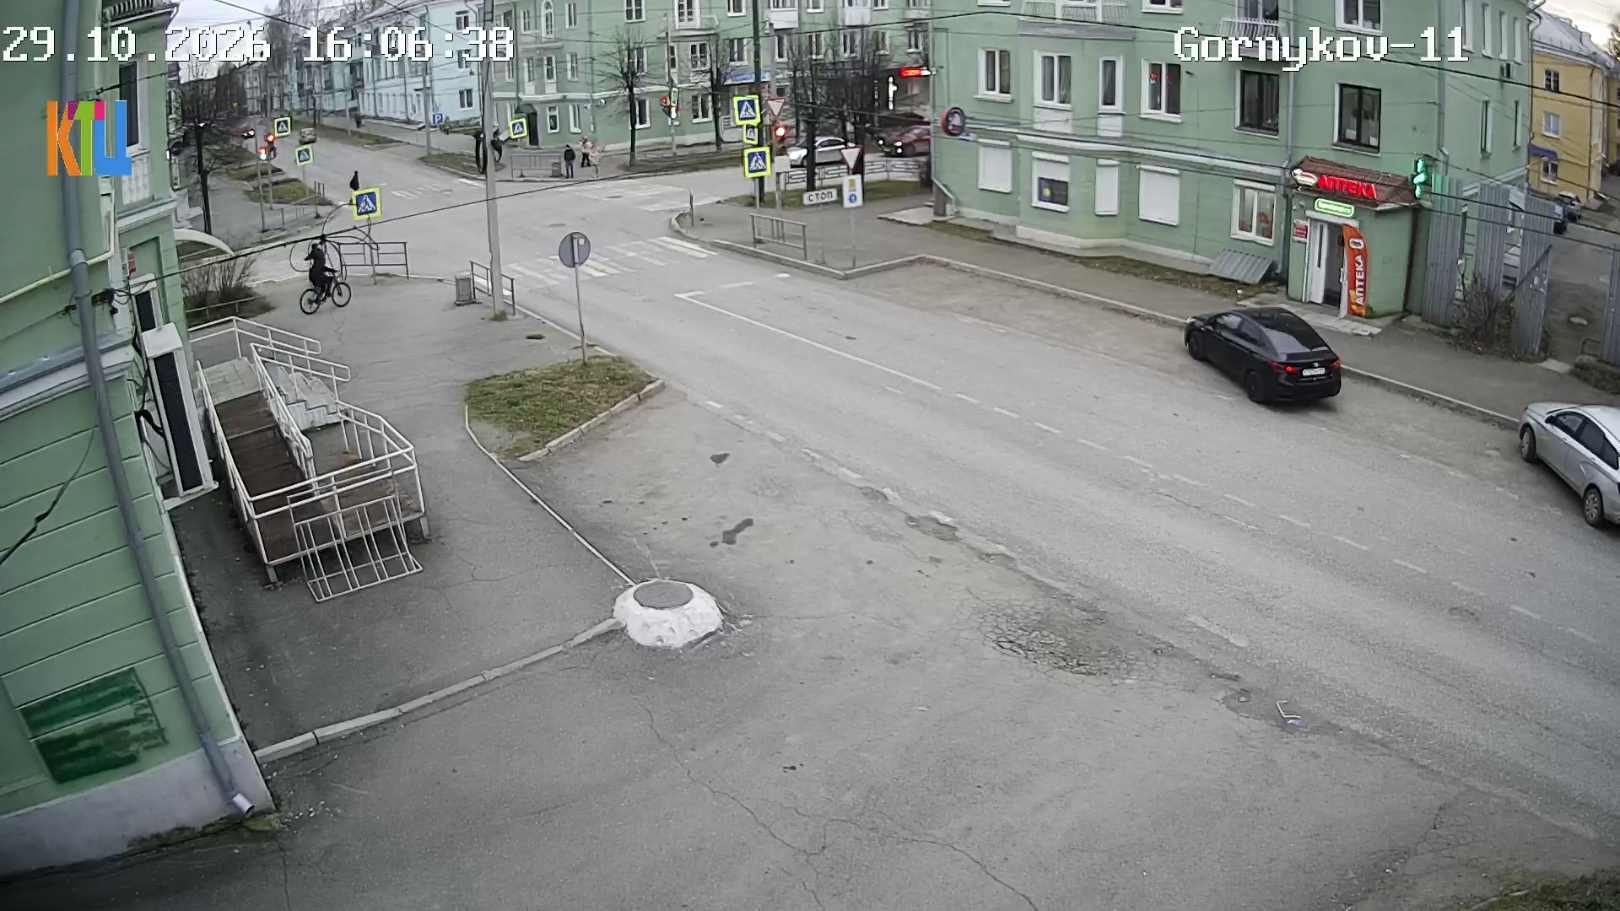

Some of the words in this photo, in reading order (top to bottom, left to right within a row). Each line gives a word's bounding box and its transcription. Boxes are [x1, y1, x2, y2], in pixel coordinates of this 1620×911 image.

[808, 191, 833, 202] СТОП
[1318, 174, 1378, 199] АПТЕКА
[1354, 254, 1365, 306] АПТЕКА
